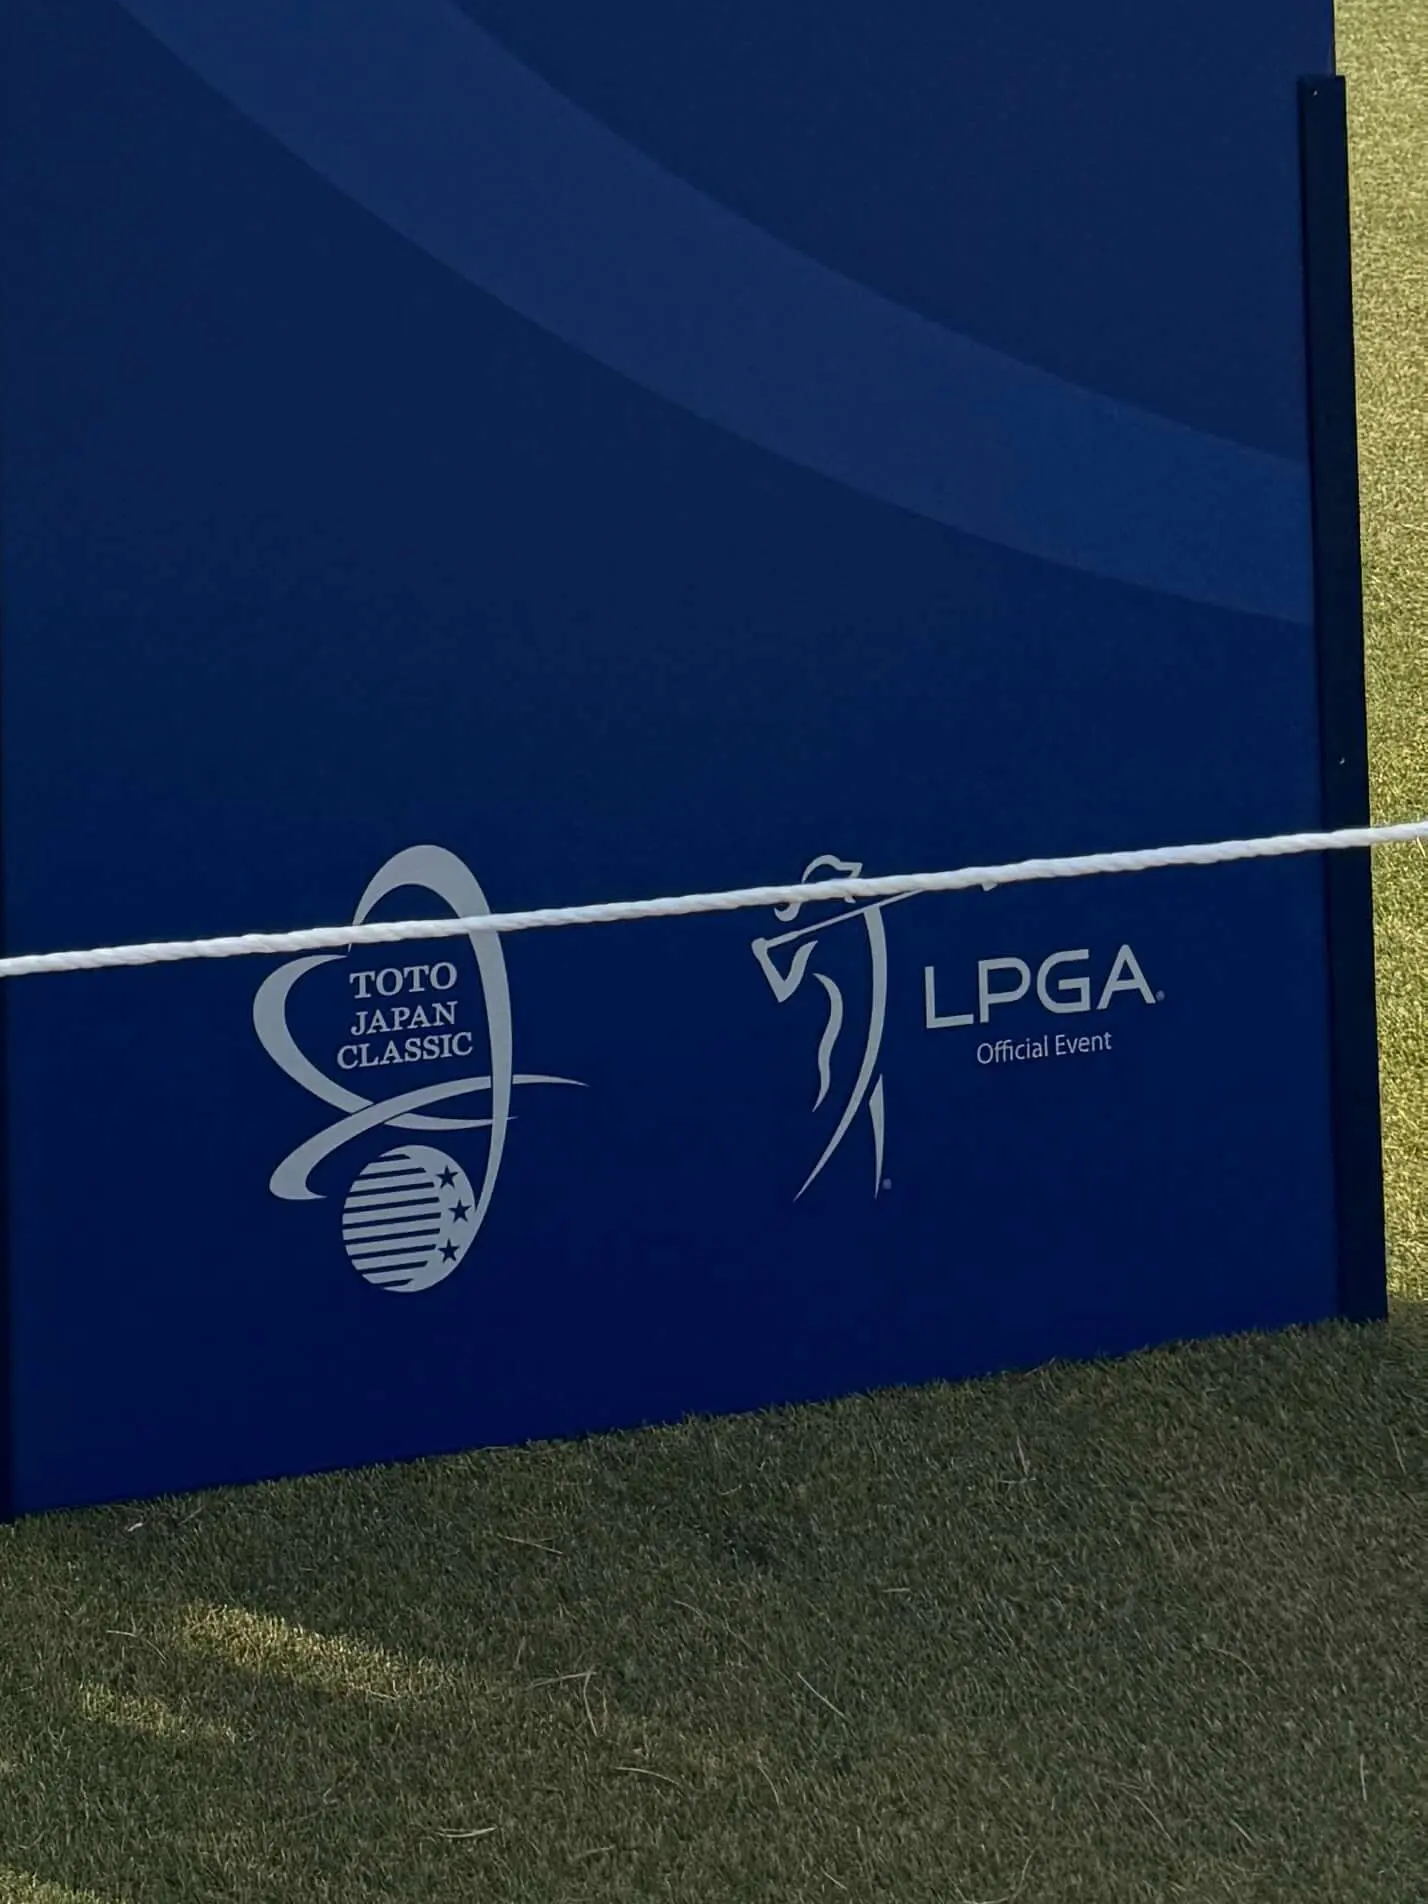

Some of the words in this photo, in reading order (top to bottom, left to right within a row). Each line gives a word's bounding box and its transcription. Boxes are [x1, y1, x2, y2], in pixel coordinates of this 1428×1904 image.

[349, 961, 458, 1000] TOTO
[924, 943, 1157, 1029] LPGA
[350, 1000, 459, 1036] JAPAN
[336, 1031, 474, 1070] CLASSIC
[976, 1034, 1049, 1065] Official
[1054, 1030, 1113, 1057] Event
